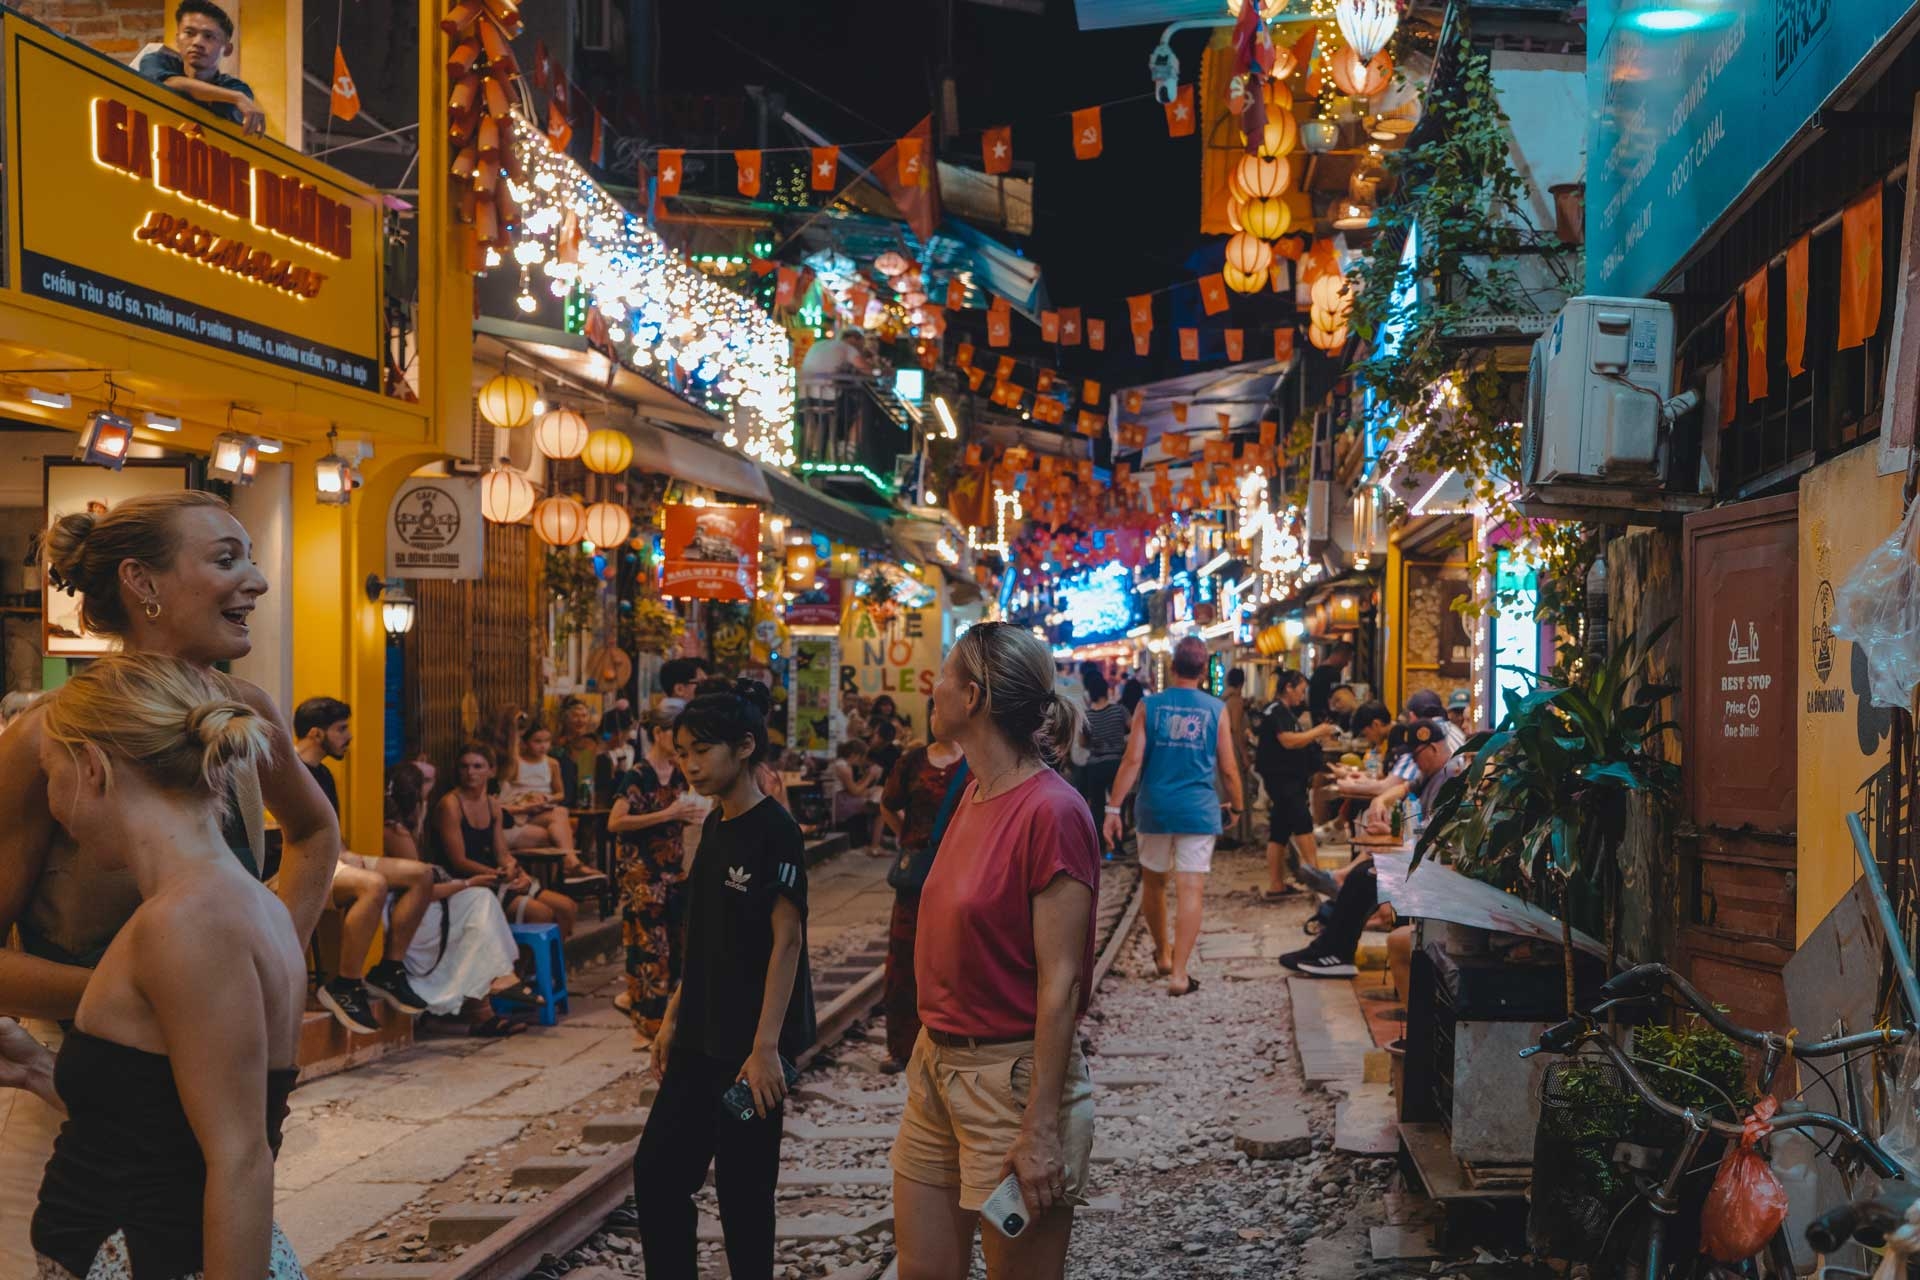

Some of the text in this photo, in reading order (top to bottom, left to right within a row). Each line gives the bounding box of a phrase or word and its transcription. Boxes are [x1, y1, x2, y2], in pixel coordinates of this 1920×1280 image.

[1672, 68, 1708, 138] CROWNS
[90, 97, 152, 180] GA
[1671, 110, 1726, 199] ROOT CANAL
[42, 270, 76, 297] CHẮN
[79, 280, 104, 304] TÀU
[107, 290, 126, 310] SỐ
[125, 298, 143, 318] 5A,
[175, 311, 200, 335] PHÚ,
[863, 638, 912, 667] NO
[838, 664, 935, 696] RULES
[1721, 674, 1772, 692] REST STOP
[1725, 701, 1747, 719] Price:
[1724, 723, 1760, 739] One Smile
